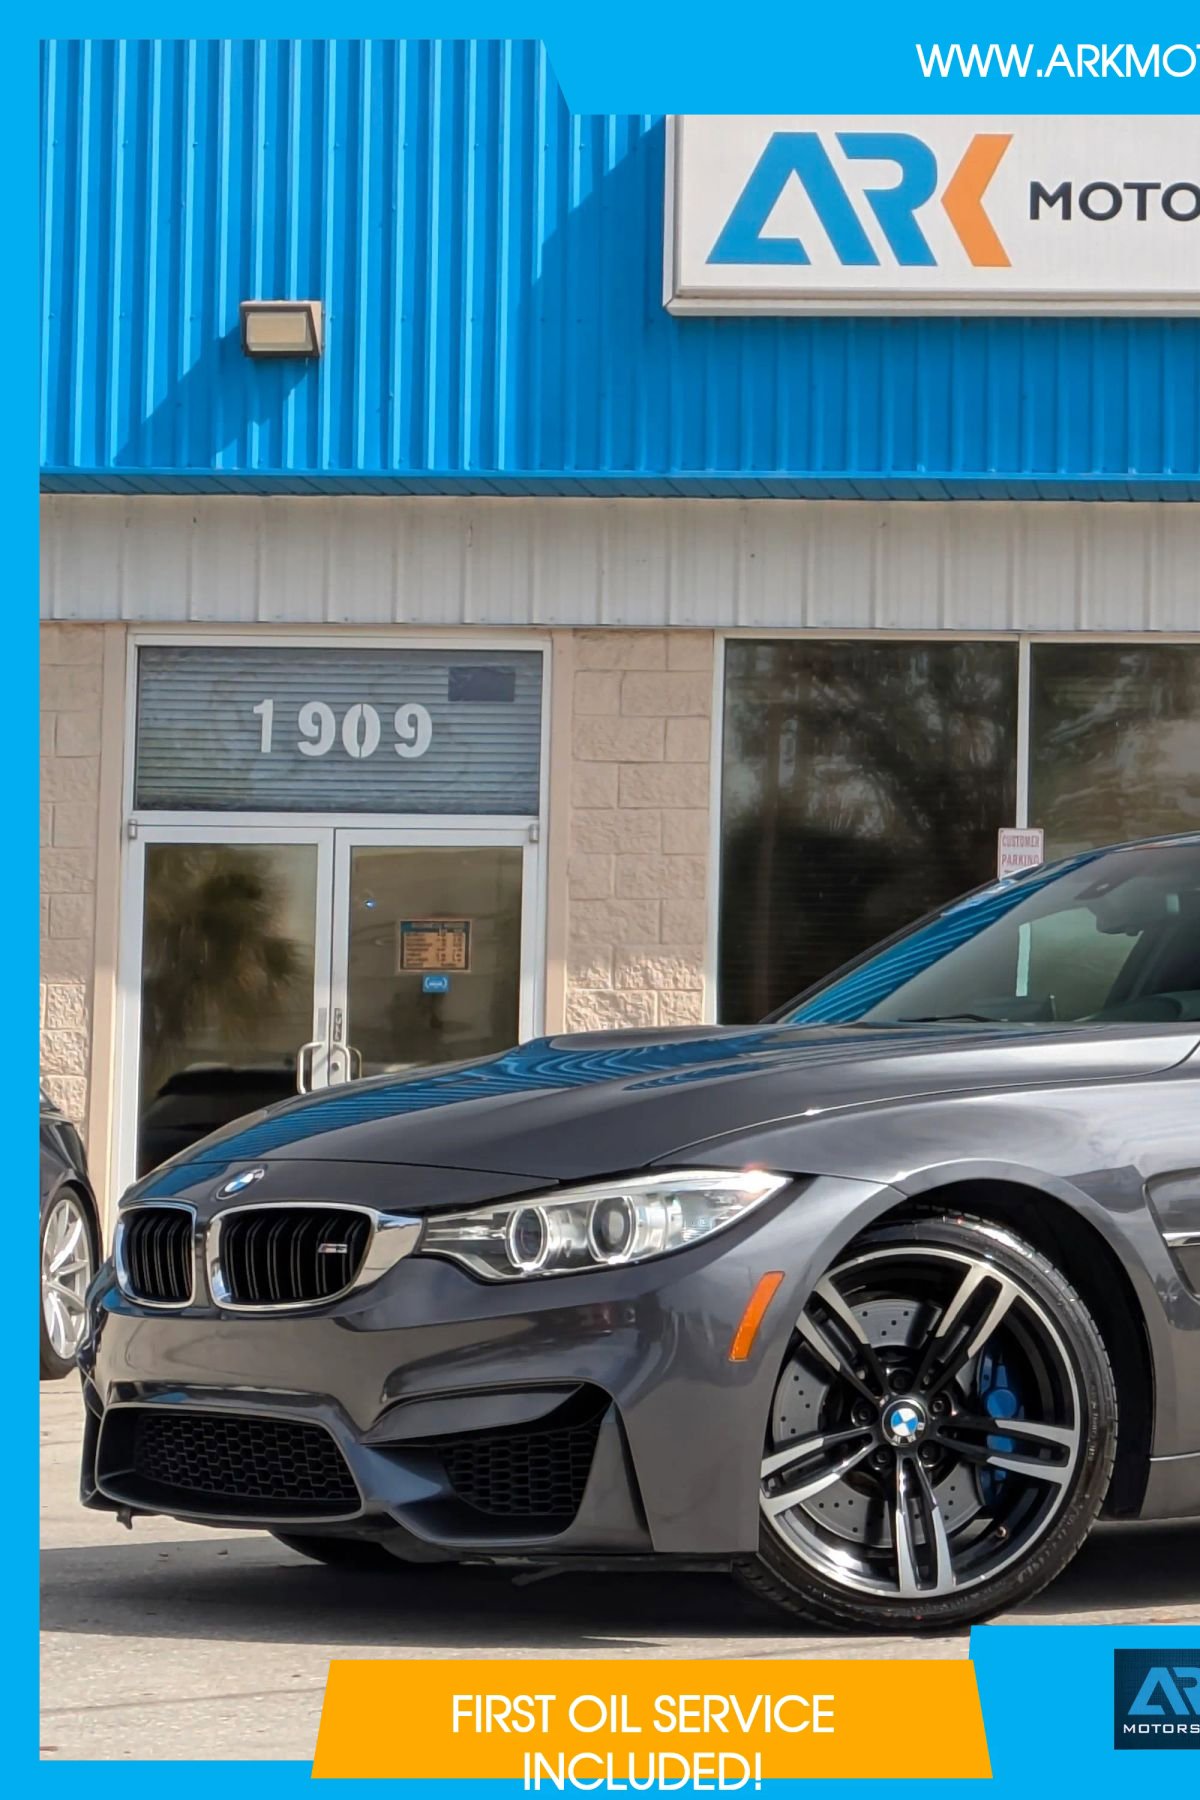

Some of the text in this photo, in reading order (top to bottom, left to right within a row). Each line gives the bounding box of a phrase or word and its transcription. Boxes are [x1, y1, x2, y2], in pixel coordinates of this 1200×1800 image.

[705, 132, 1014, 268] ARK
[253, 699, 433, 759] 1909
[1002, 835, 1040, 848] CUSTOMER
[1001, 854, 1040, 866] PARKING
